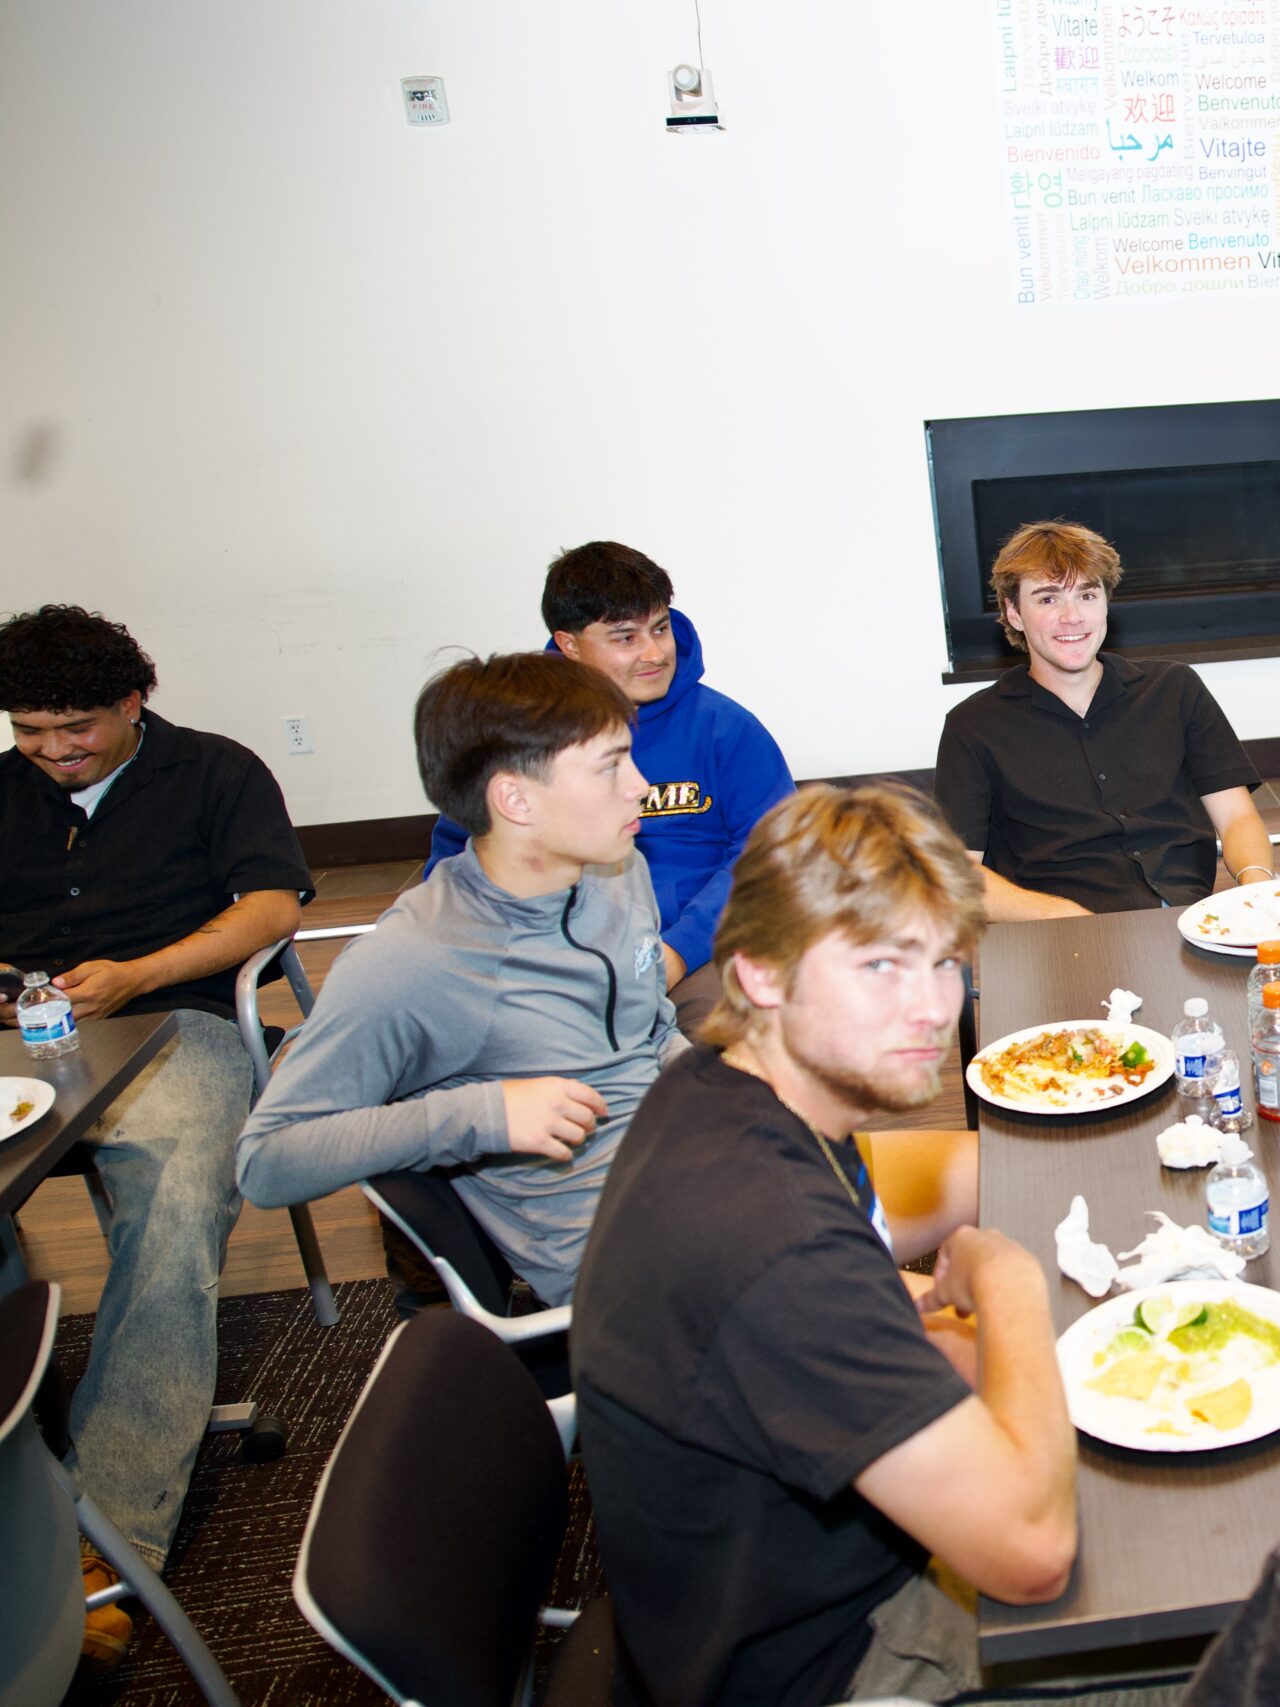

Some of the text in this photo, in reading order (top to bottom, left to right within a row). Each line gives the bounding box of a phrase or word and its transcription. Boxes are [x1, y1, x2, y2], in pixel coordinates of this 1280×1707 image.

[1052, 13, 1098, 43] Vitajte
[1120, 5, 1176, 38] ようこそ
[1192, 31, 1265, 45] Tervetuloa
[1121, 69, 1180, 88] Welkom
[1195, 73, 1267, 90] Welcome
[1123, 92, 1176, 123] 欢迎
[1005, 120, 1045, 142] Laipni
[1105, 117, 1174, 162] مرحبا
[1007, 143, 1101, 163] Bienvenido
[1200, 136, 1267, 163] Vitajte
[1199, 163, 1268, 181] Benvingut
[1067, 187, 1137, 206] Bun venit
[1070, 210, 1114, 236] Laipni
[1173, 206, 1219, 227] Sveiki
[1113, 231, 1271, 254] Welcome Benvenuto
[1010, 214, 1036, 304] venit Bun
[1093, 236, 1111, 301] Welkom
[1114, 254, 1252, 275] Velkommen
[641, 782, 700, 811] ME
